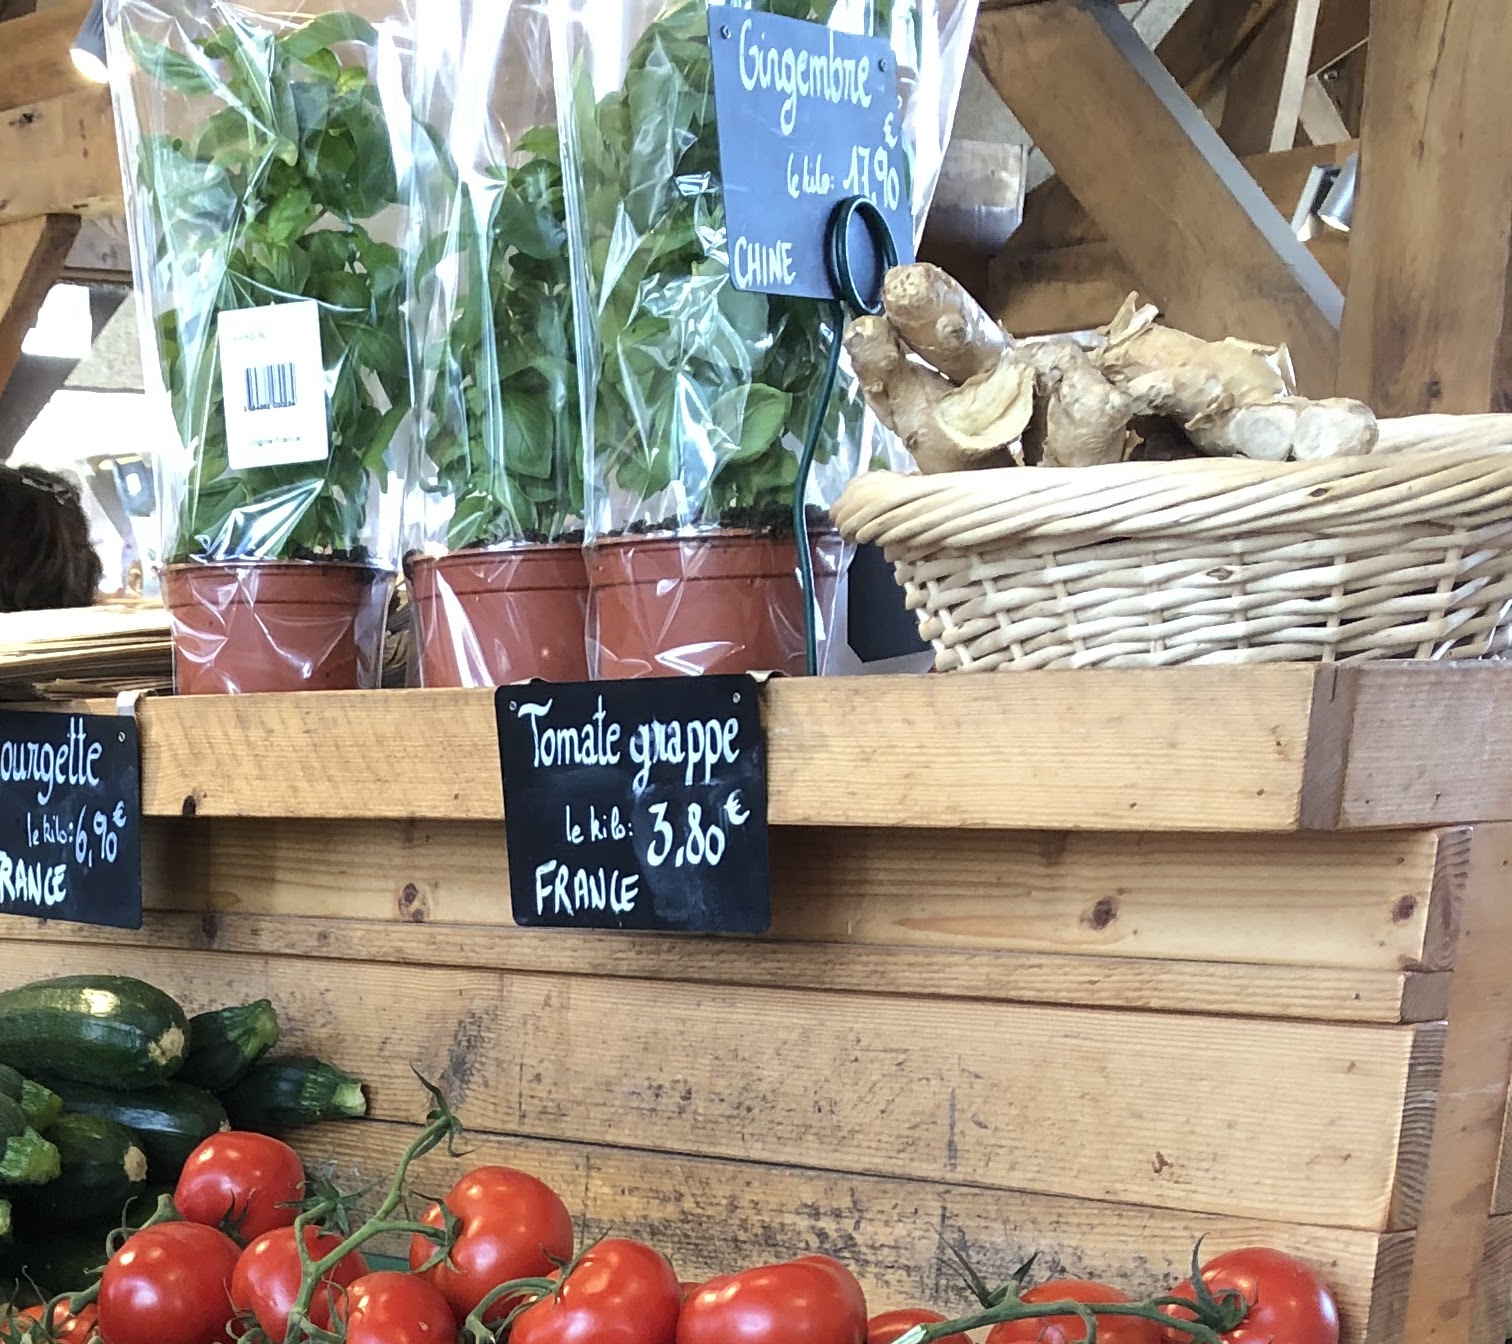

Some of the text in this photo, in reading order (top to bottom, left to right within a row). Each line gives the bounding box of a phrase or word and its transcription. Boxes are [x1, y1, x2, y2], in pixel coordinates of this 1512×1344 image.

[739, 19, 872, 135] Gingembre
[734, 236, 796, 288] CHINE
[517, 695, 740, 797] Tomate grappe
[27, 811, 39, 848] le
[565, 805, 584, 844] le
[535, 859, 639, 916] FRANCE
